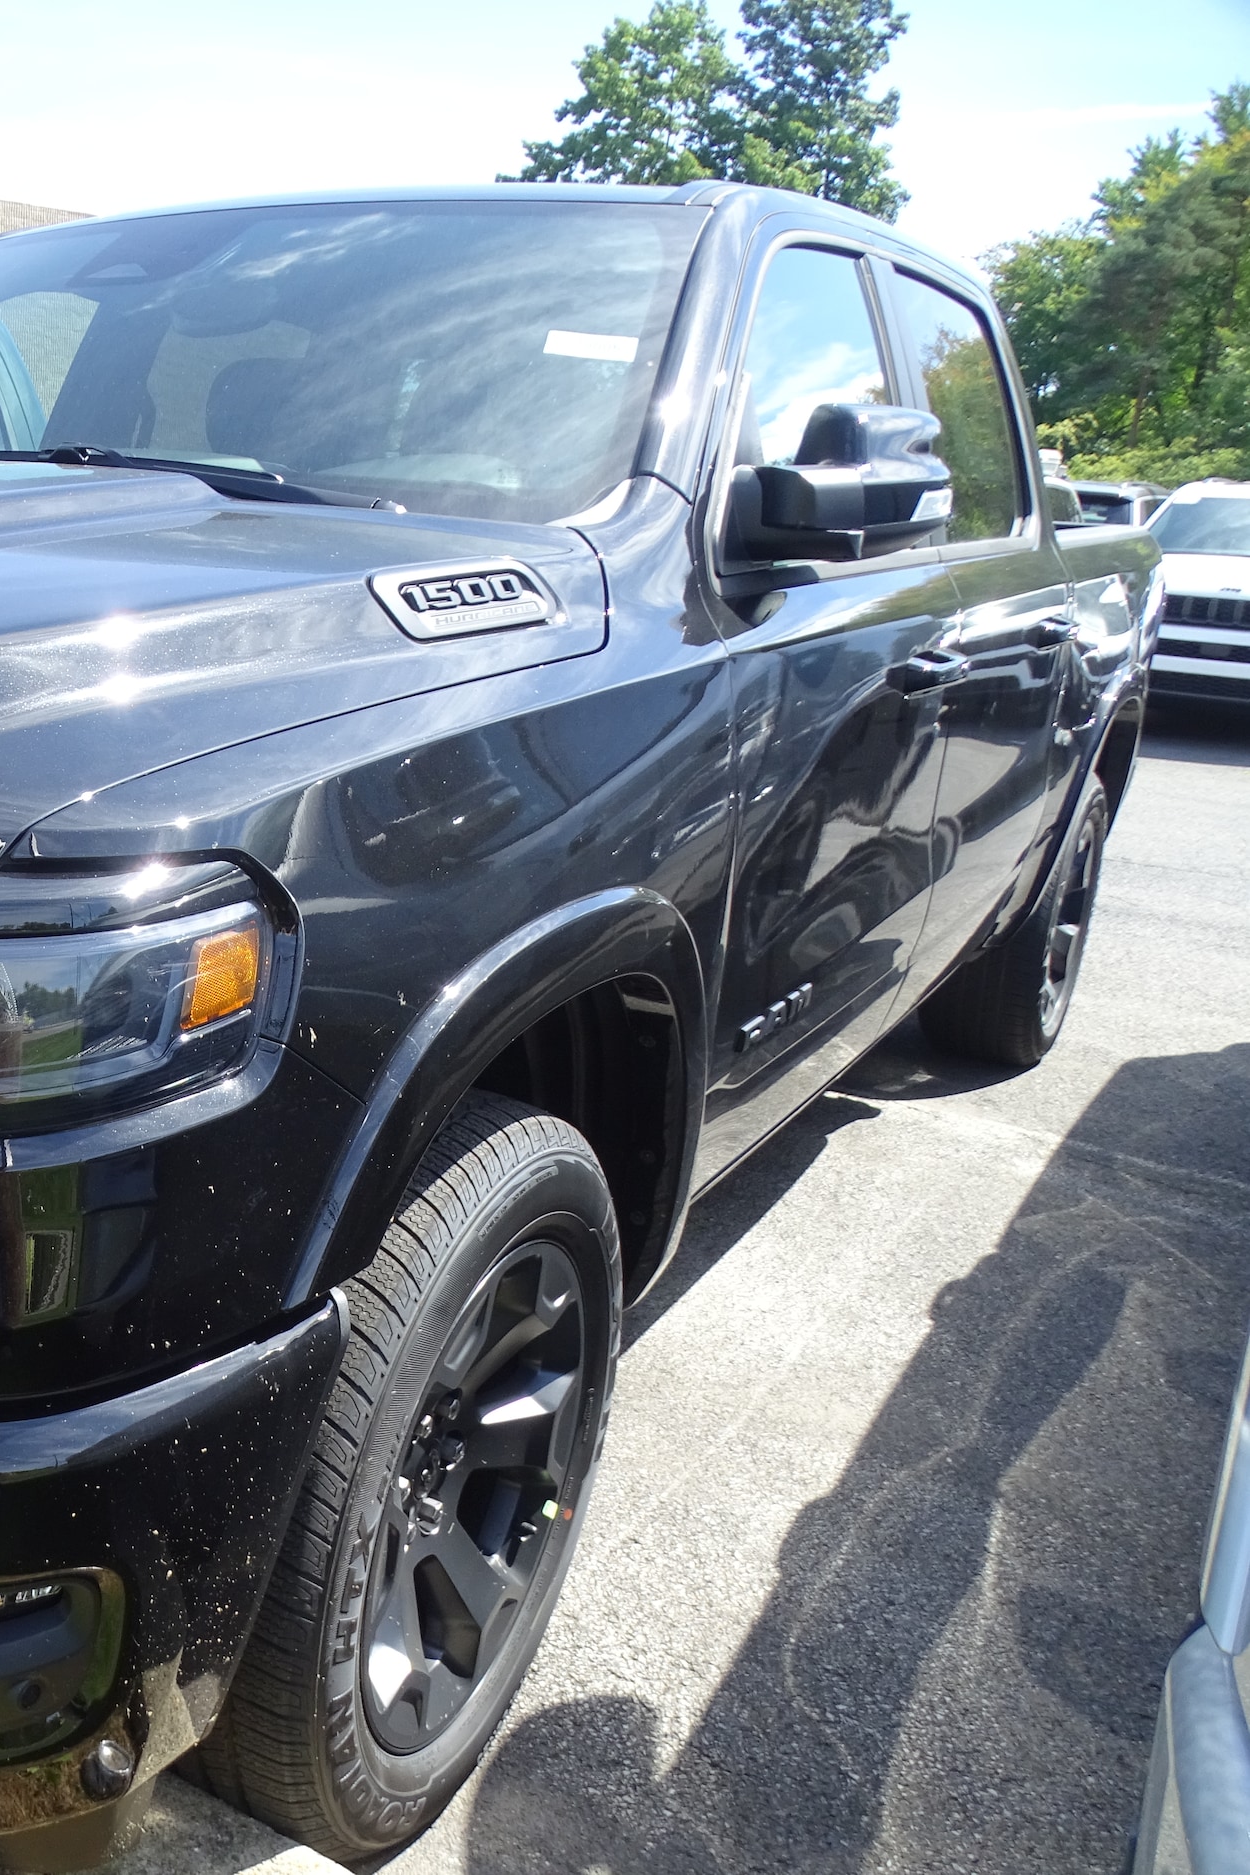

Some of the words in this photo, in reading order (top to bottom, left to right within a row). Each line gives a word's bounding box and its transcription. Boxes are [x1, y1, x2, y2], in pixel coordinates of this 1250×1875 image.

[401, 573, 524, 613] 1500
[435, 604, 536, 626] HURRICANE
[734, 981, 813, 1053] RAM
